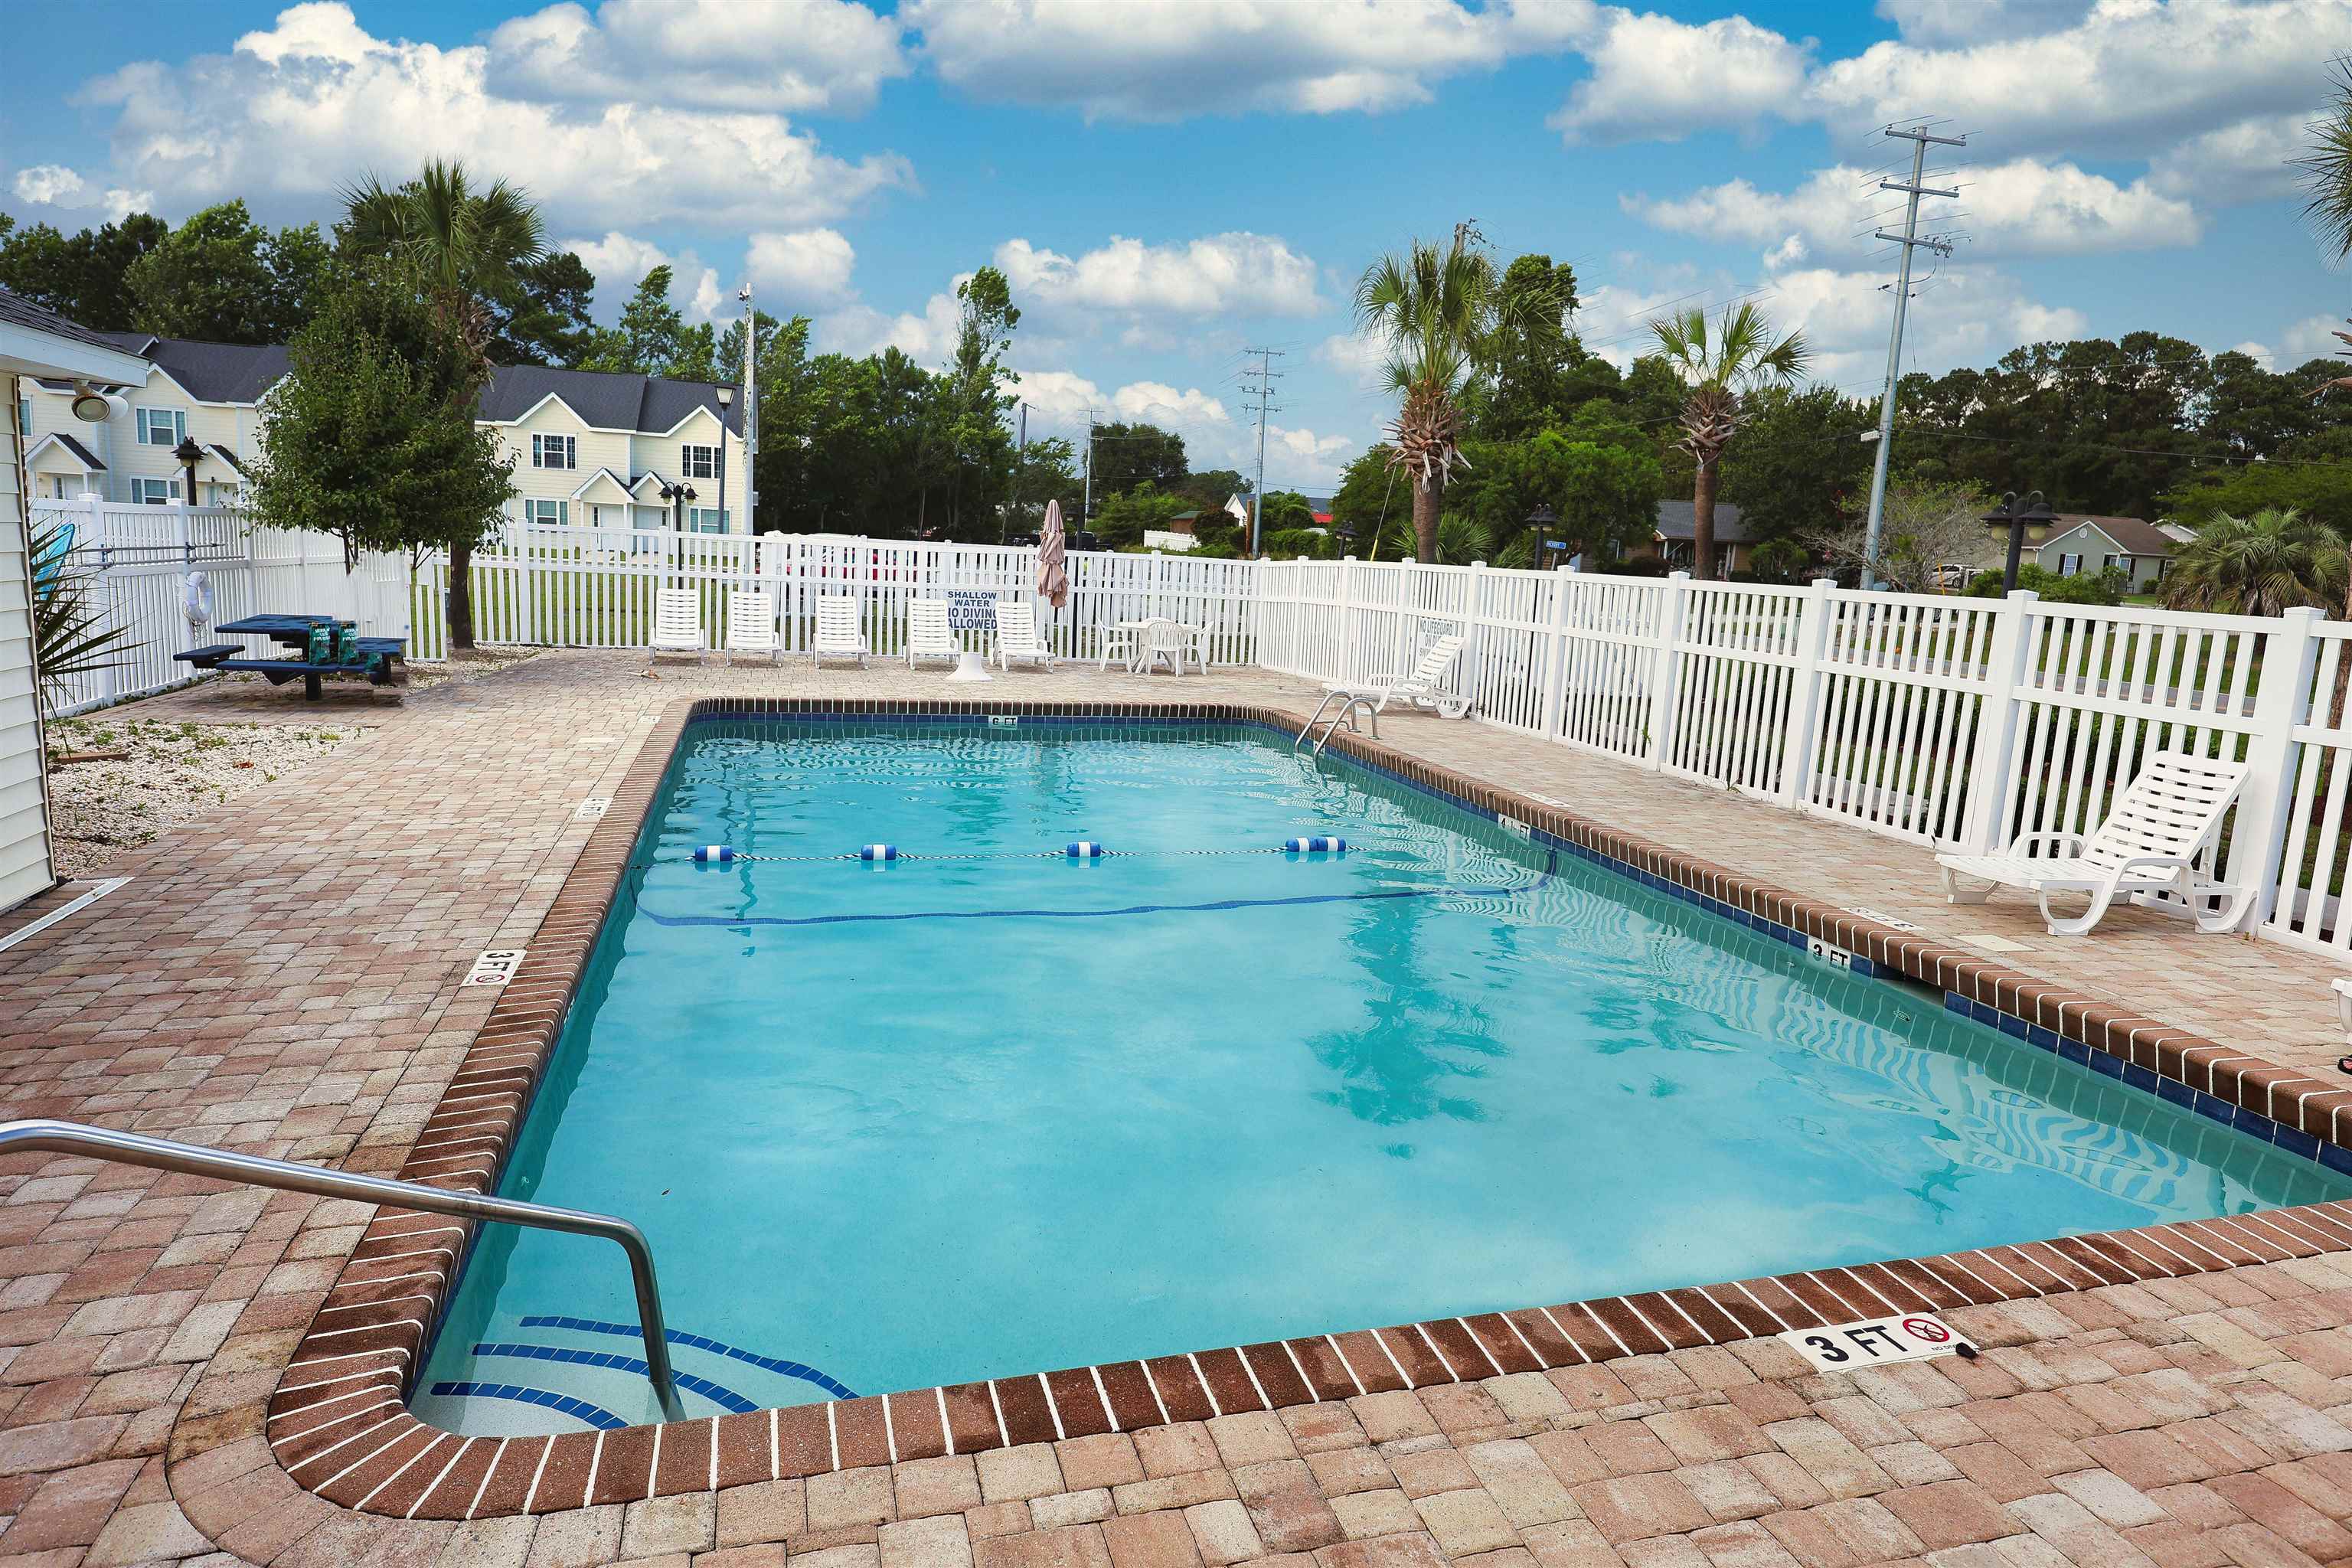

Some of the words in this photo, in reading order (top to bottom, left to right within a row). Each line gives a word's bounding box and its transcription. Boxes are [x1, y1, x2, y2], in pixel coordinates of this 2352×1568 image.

[948, 591, 997, 599] SHALLOW
[948, 618, 998, 629] ALLOWED
[1421, 619, 1426, 633] NO
[1427, 619, 1453, 636] LIFEGUARD
[1519, 825, 1530, 841] FT
[1831, 949, 1848, 968] FT
[478, 962, 511, 972] FT
[1805, 1335, 1850, 1362] 3
[1842, 1325, 1909, 1357] FT
